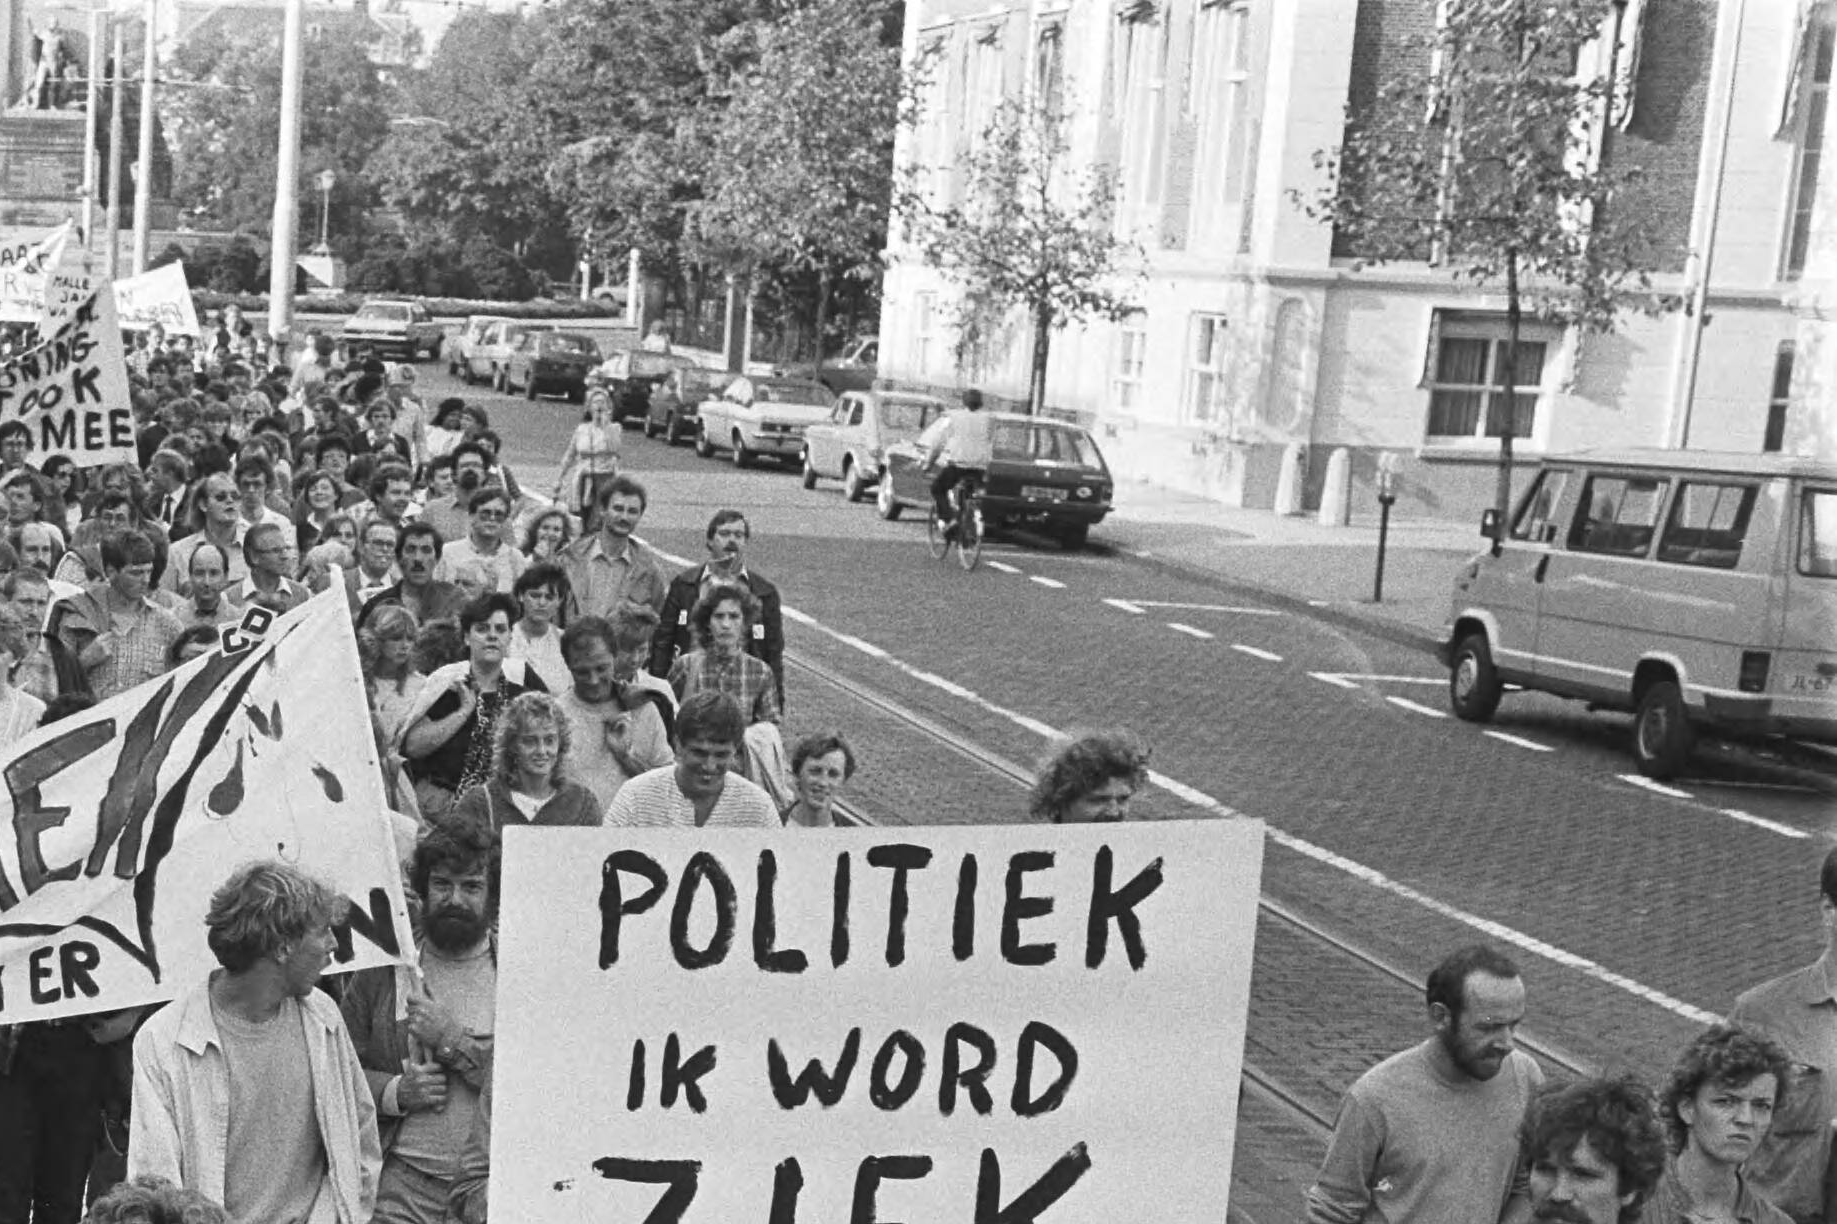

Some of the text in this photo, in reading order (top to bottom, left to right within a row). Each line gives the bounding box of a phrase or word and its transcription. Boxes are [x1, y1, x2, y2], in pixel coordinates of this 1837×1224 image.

[18, 366, 102, 416] OOK
[40, 408, 135, 452] MEE
[597, 843, 1164, 974] POLITIEK
[29, 941, 101, 1004] ER
[625, 1031, 717, 1114] IK
[767, 1020, 1080, 1118] WORD
